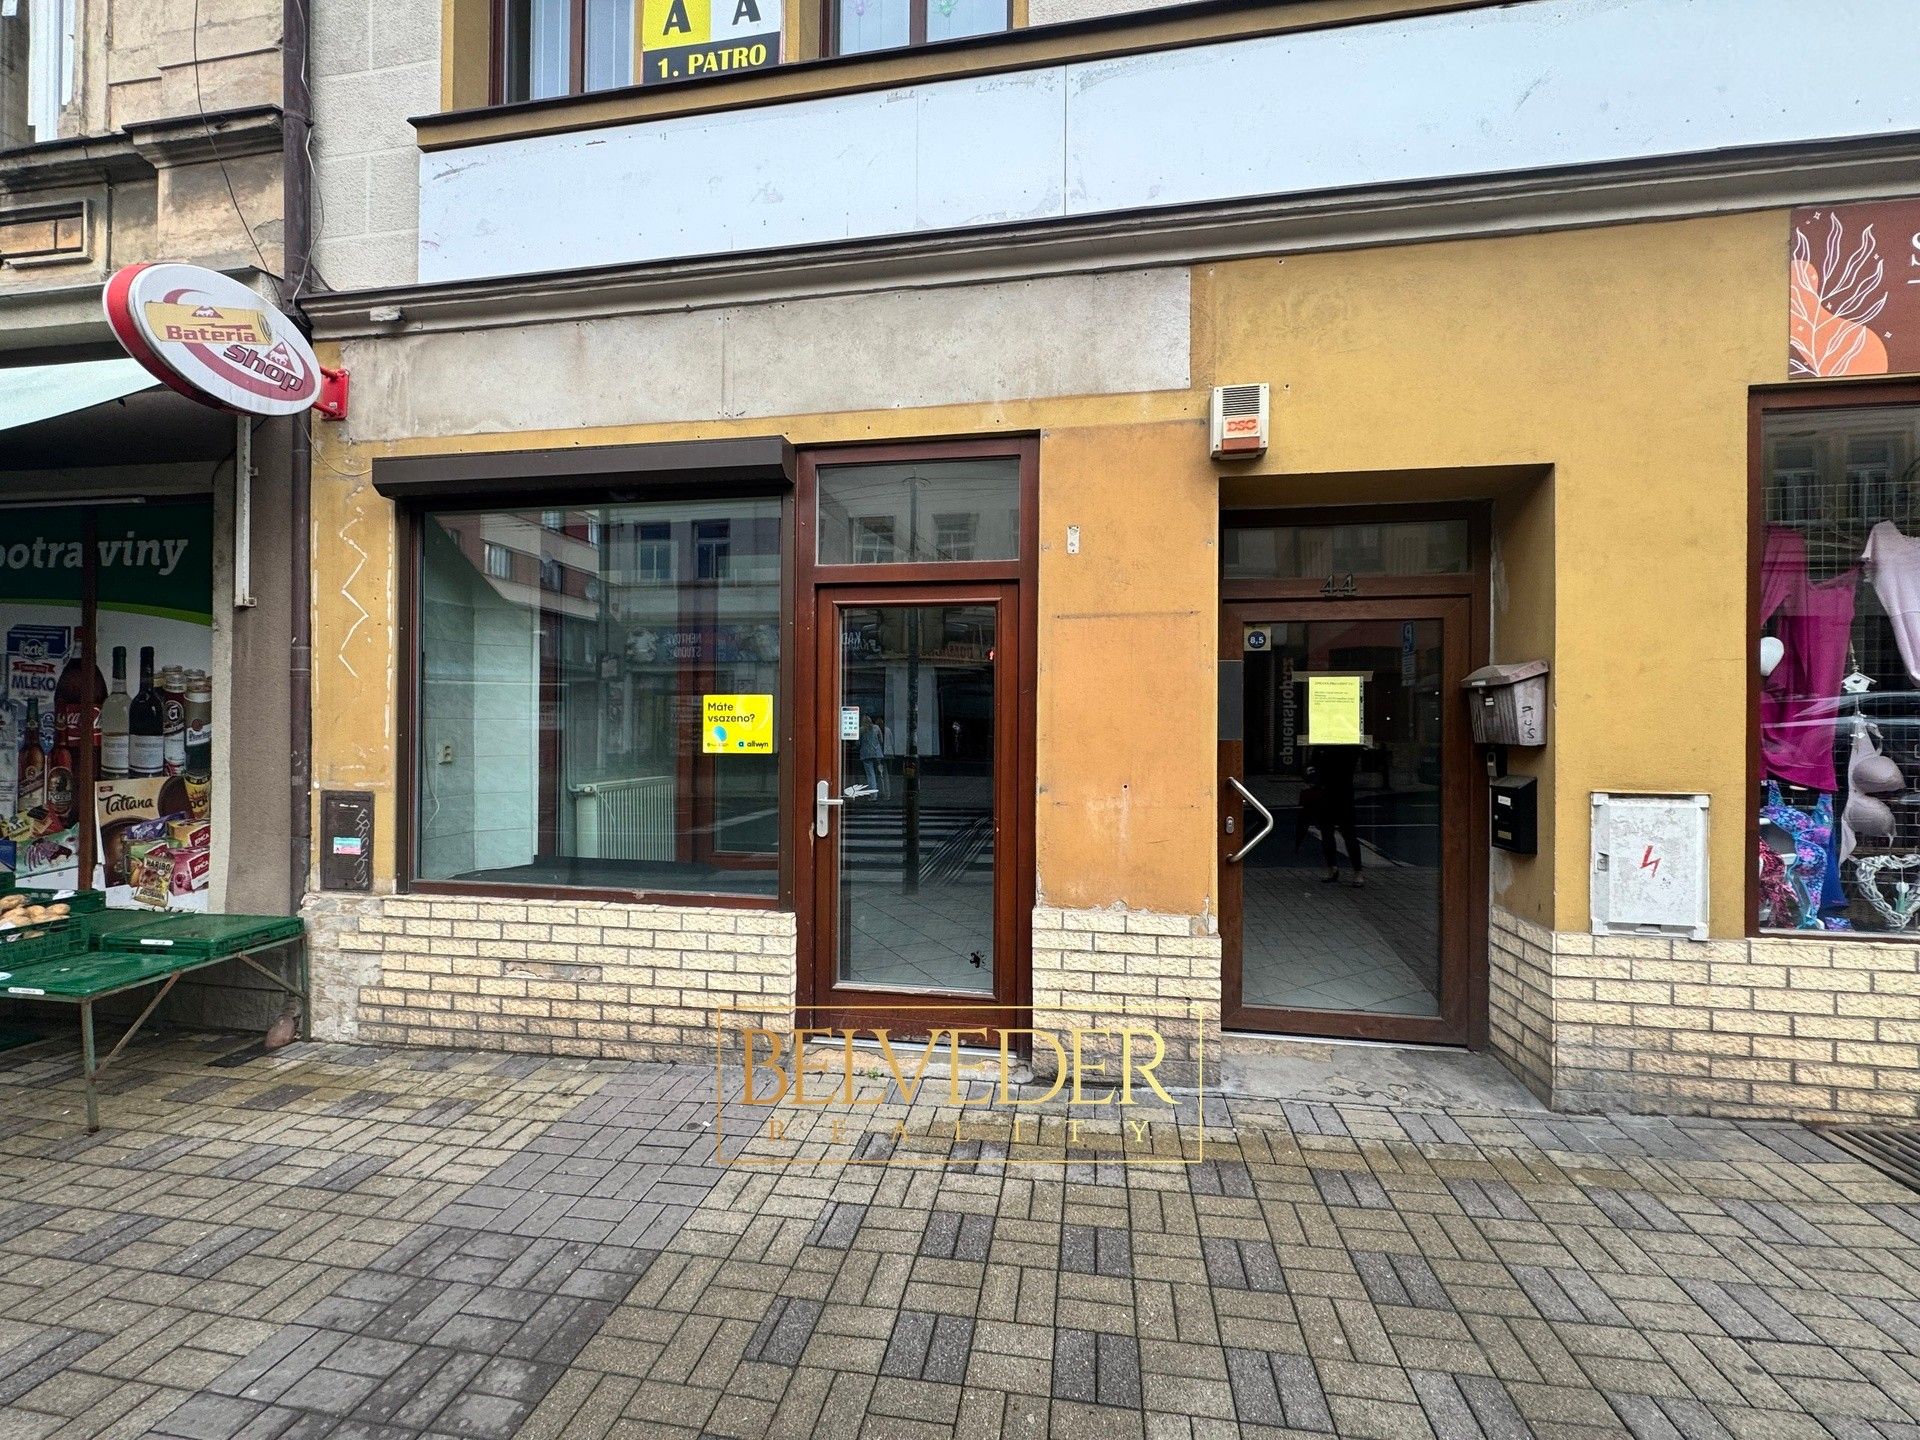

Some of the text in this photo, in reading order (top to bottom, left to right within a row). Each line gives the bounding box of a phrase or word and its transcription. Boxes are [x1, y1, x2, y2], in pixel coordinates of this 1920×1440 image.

[663, 0, 691, 36] A
[658, 44, 767, 79] 1. PATRO
[1227, 418, 1258, 432] DSC
[1319, 573, 1357, 598] 44
[12, 673, 56, 692] MLÉKO
[708, 702, 734, 711] Máte
[708, 713, 755, 723] vsazeno?
[746, 741, 768, 749] allwyn
[146, 858, 171, 872] HARIBO
